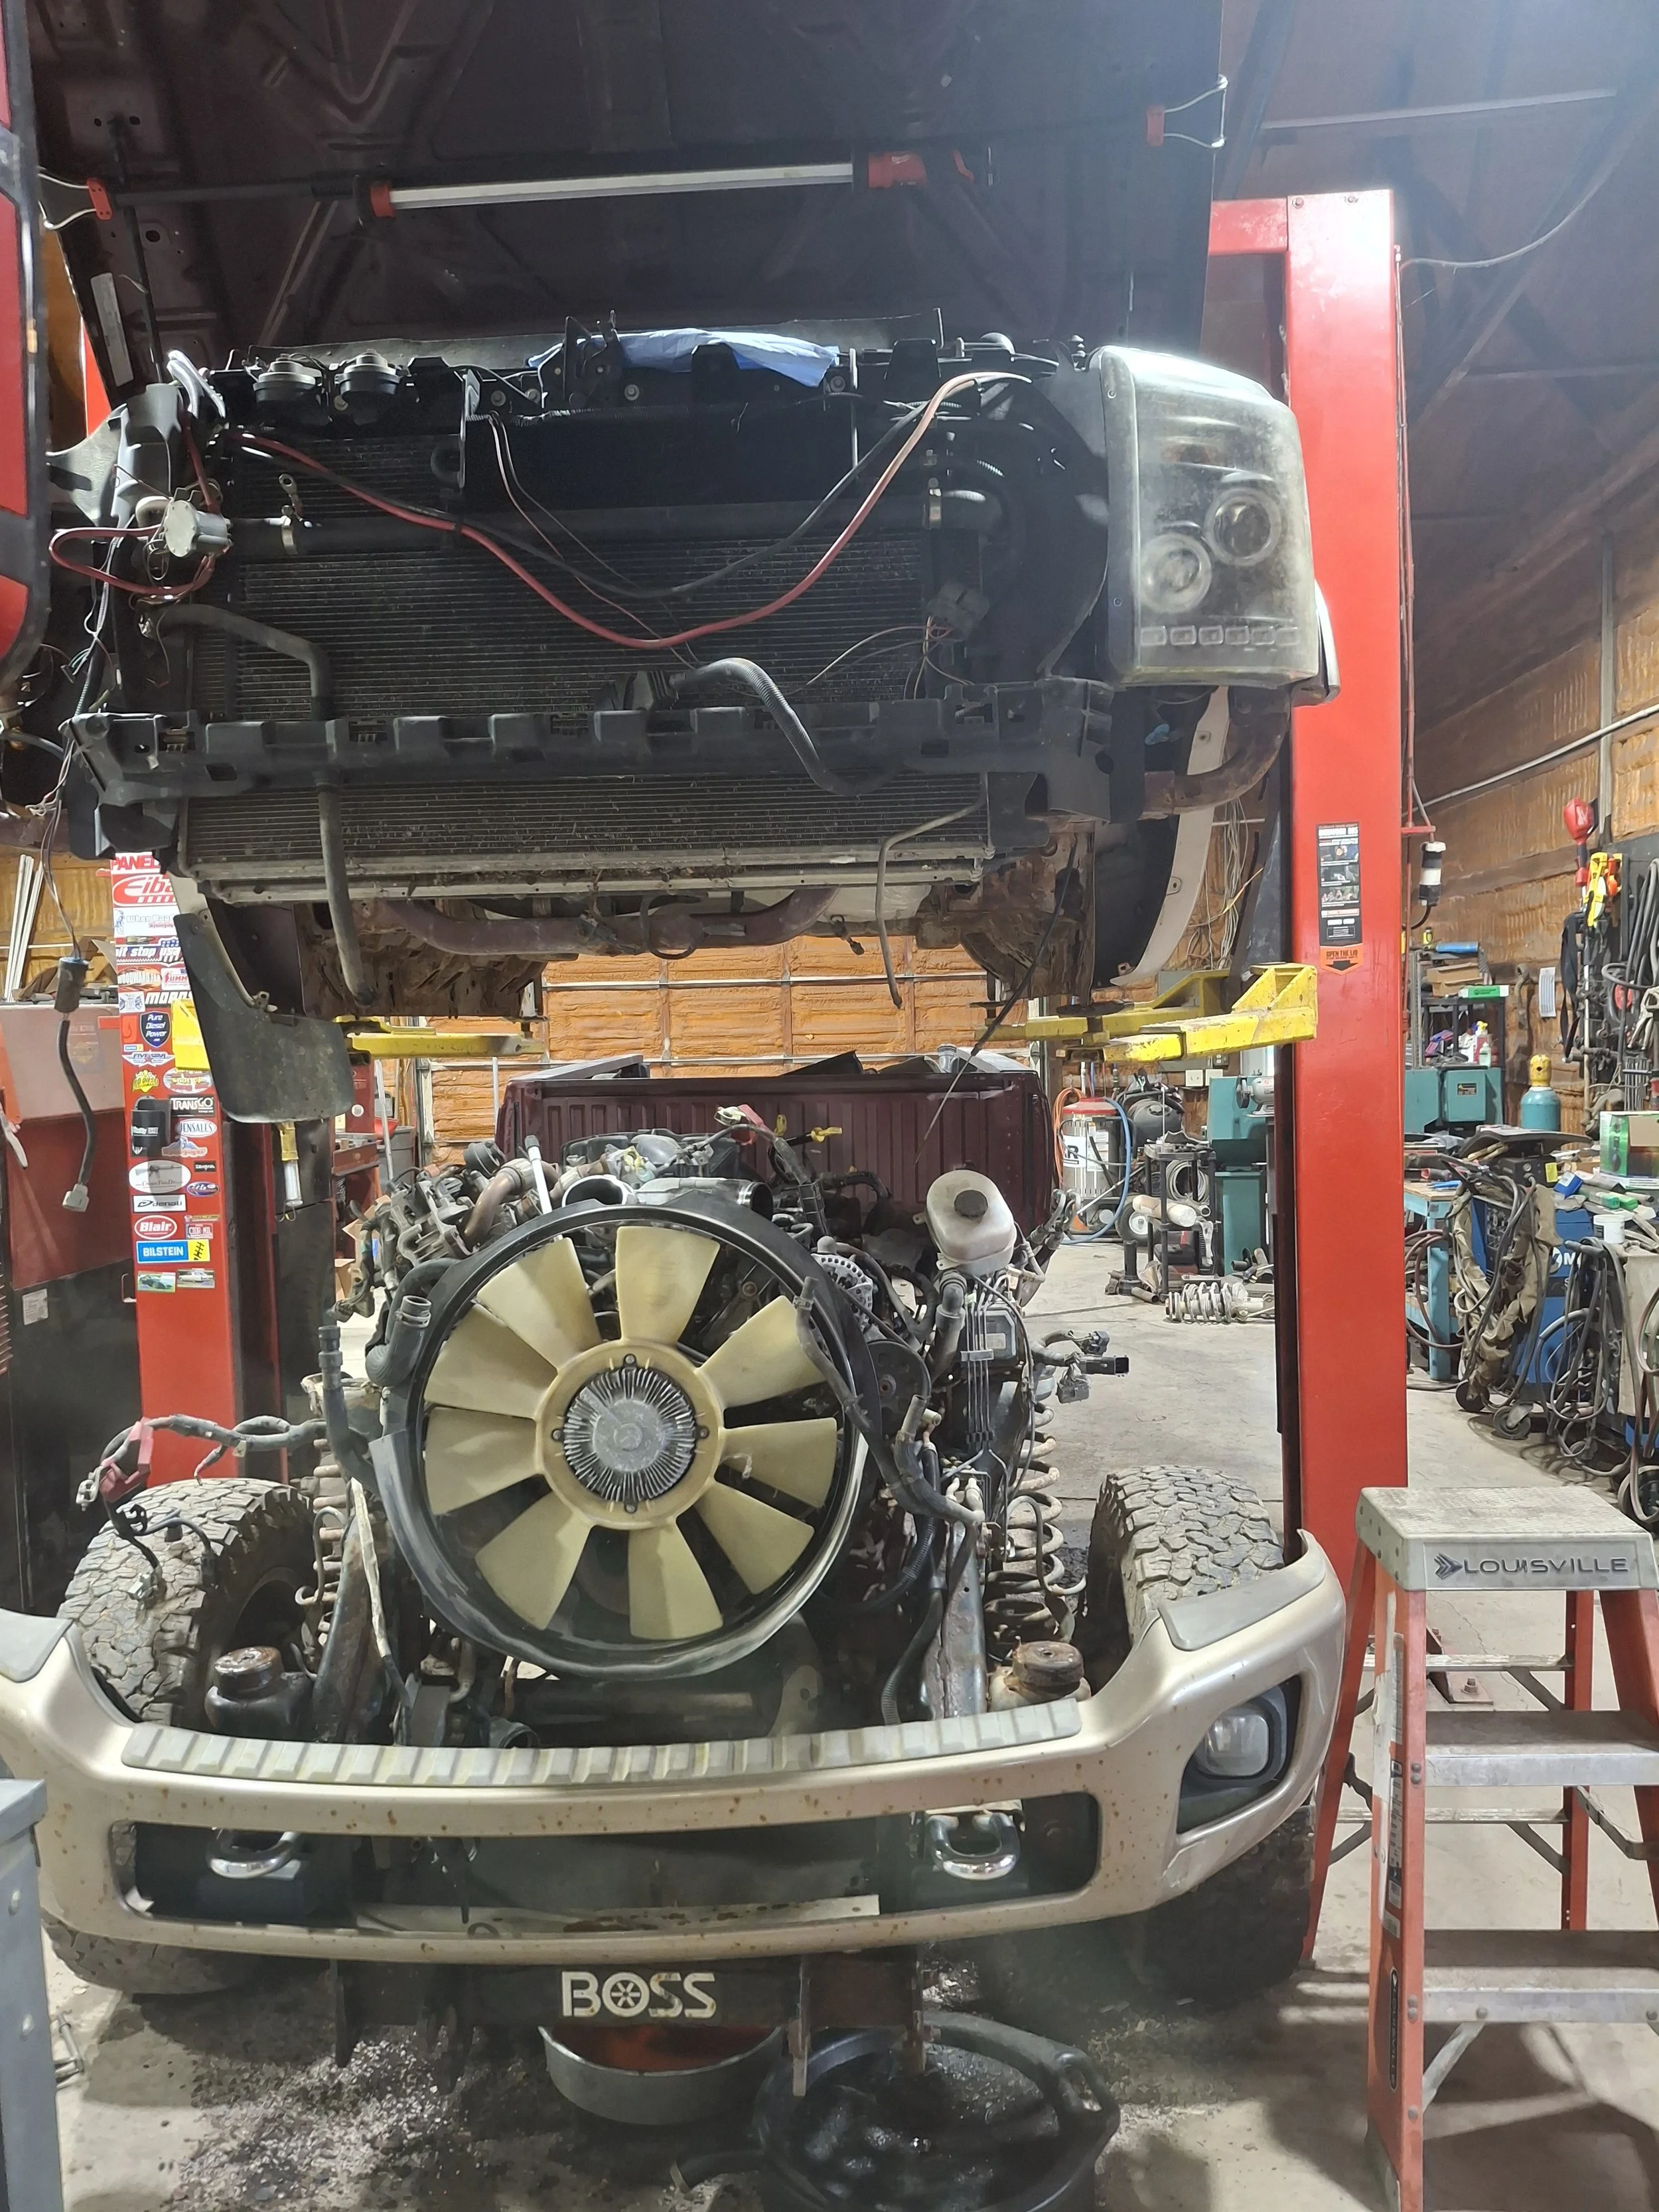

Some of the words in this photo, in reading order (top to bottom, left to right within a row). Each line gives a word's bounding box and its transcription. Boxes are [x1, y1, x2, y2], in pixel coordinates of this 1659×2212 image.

[130, 947, 157, 958] stop
[139, 1220, 172, 1232] Blair
[143, 1246, 184, 1257] BILSTEIN
[1463, 1557, 1629, 1574] LOUISVILLE
[561, 1971, 717, 2019] BOSS
